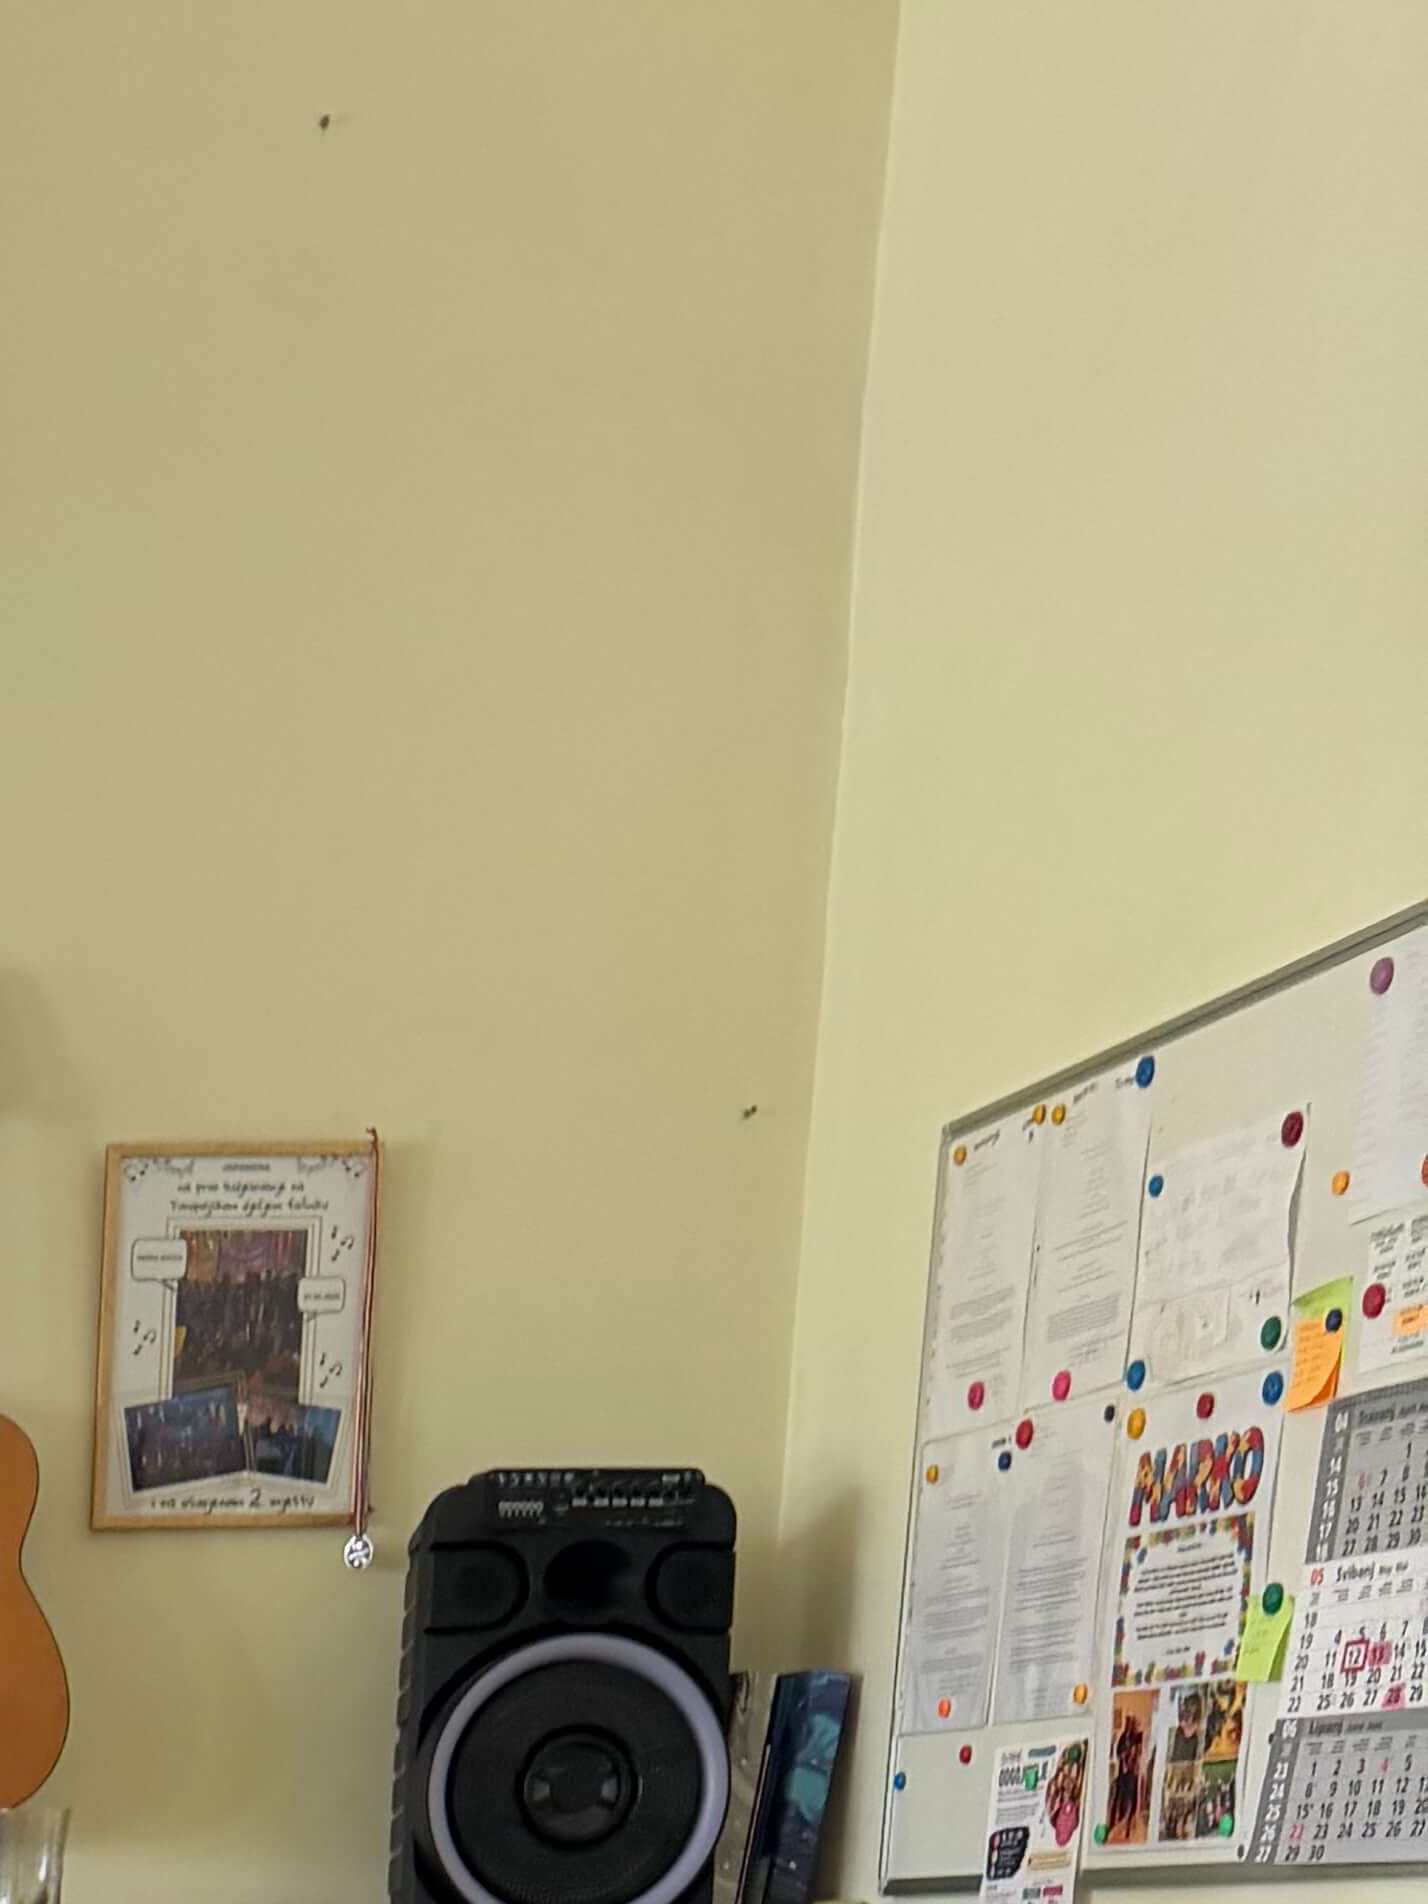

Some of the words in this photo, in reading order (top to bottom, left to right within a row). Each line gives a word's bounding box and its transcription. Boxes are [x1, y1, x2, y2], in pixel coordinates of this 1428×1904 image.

[1128, 1426, 1264, 1527] MARKO
[249, 1488, 263, 1509] 2
[1310, 1568, 1324, 1586] 05
[1294, 1655, 1309, 1671] 20
[1325, 1651, 1337, 1667] 11
[1348, 1647, 1361, 1665] 12
[1372, 1645, 1385, 1661] 13
[1394, 1642, 1406, 1658] 14
[1290, 1676, 1304, 1693] 21
[1321, 1673, 1334, 1689] 18
[1344, 1671, 1357, 1687] 19
[1367, 1668, 1381, 1684] 20
[1390, 1664, 1402, 1682] 21
[1411, 1662, 1425, 1680] 22
[1288, 1696, 1301, 1713] 22
[1317, 1694, 1331, 1711] 25
[1340, 1691, 1354, 1708] 26
[1363, 1689, 1377, 1706] 27
[1388, 1687, 1401, 1704] 28
[1410, 1684, 1423, 1702] 29
[1311, 1760, 1317, 1777] 1
[1333, 1759, 1341, 1776] 2
[1357, 1758, 1365, 1774] 3
[1405, 1754, 1412, 1771] 5
[1305, 1782, 1313, 1798] 8
[1329, 1781, 1338, 1797] 9
[1349, 1779, 1362, 1796] 10
[1371, 1778, 1384, 1795] 11
[1396, 1776, 1409, 1793] 12
[1320, 1802, 1334, 1819] 16
[1344, 1801, 1358, 1816] 17
[1367, 1800, 1381, 1817] 18
[1393, 1800, 1406, 1815] 19
[1289, 1824, 1304, 1840] 22
[1313, 1824, 1328, 1839] 23
[1337, 1823, 1353, 1839] 24
[1361, 1822, 1376, 1838] 25
[1385, 1821, 1402, 1838] 26
[1410, 1819, 1426, 1837] 27
